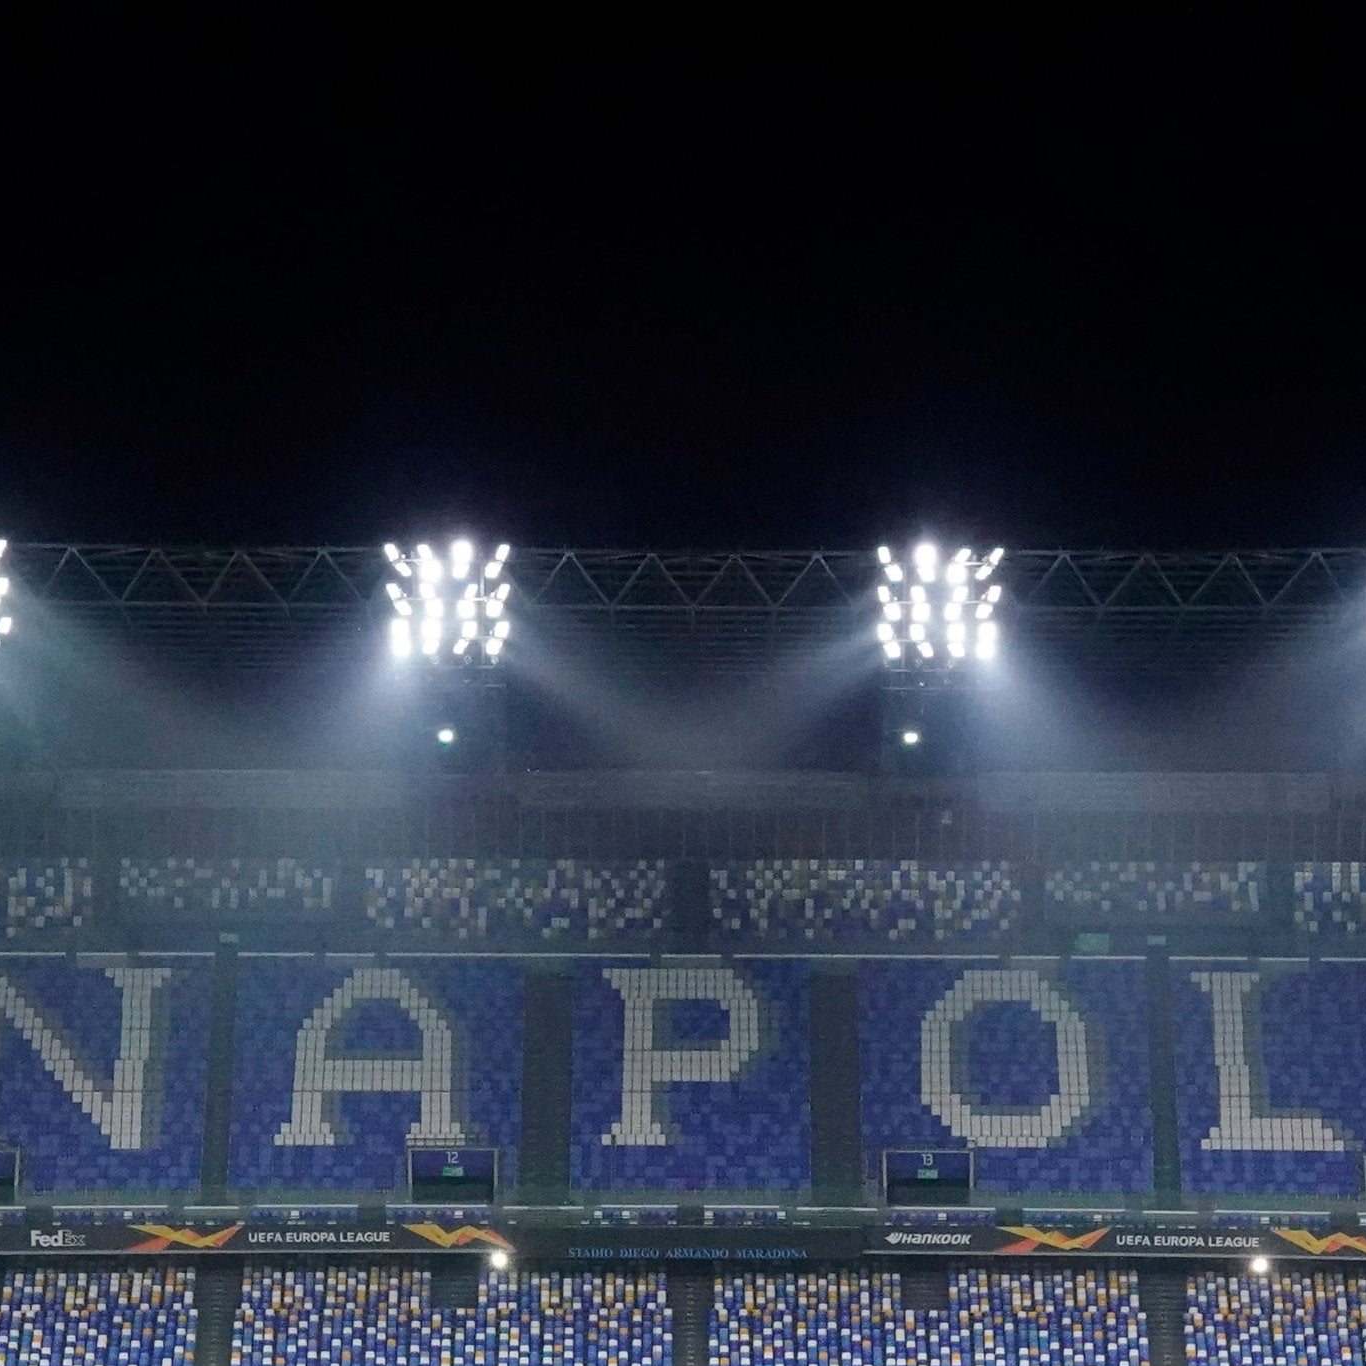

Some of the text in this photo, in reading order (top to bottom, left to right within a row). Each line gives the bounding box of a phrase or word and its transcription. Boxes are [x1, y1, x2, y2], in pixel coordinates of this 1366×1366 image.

[446, 1151, 460, 1164] 12
[921, 1153, 934, 1165] 13
[31, 1230, 86, 1247] FedEx
[248, 1231, 390, 1244] UEFA EUROPA LEAGUE
[1116, 1234, 1260, 1248] UEFA EUROPA LEAGUE
[568, 1247, 808, 1259] STADIO DIEGO ARMANDO MARADONA
